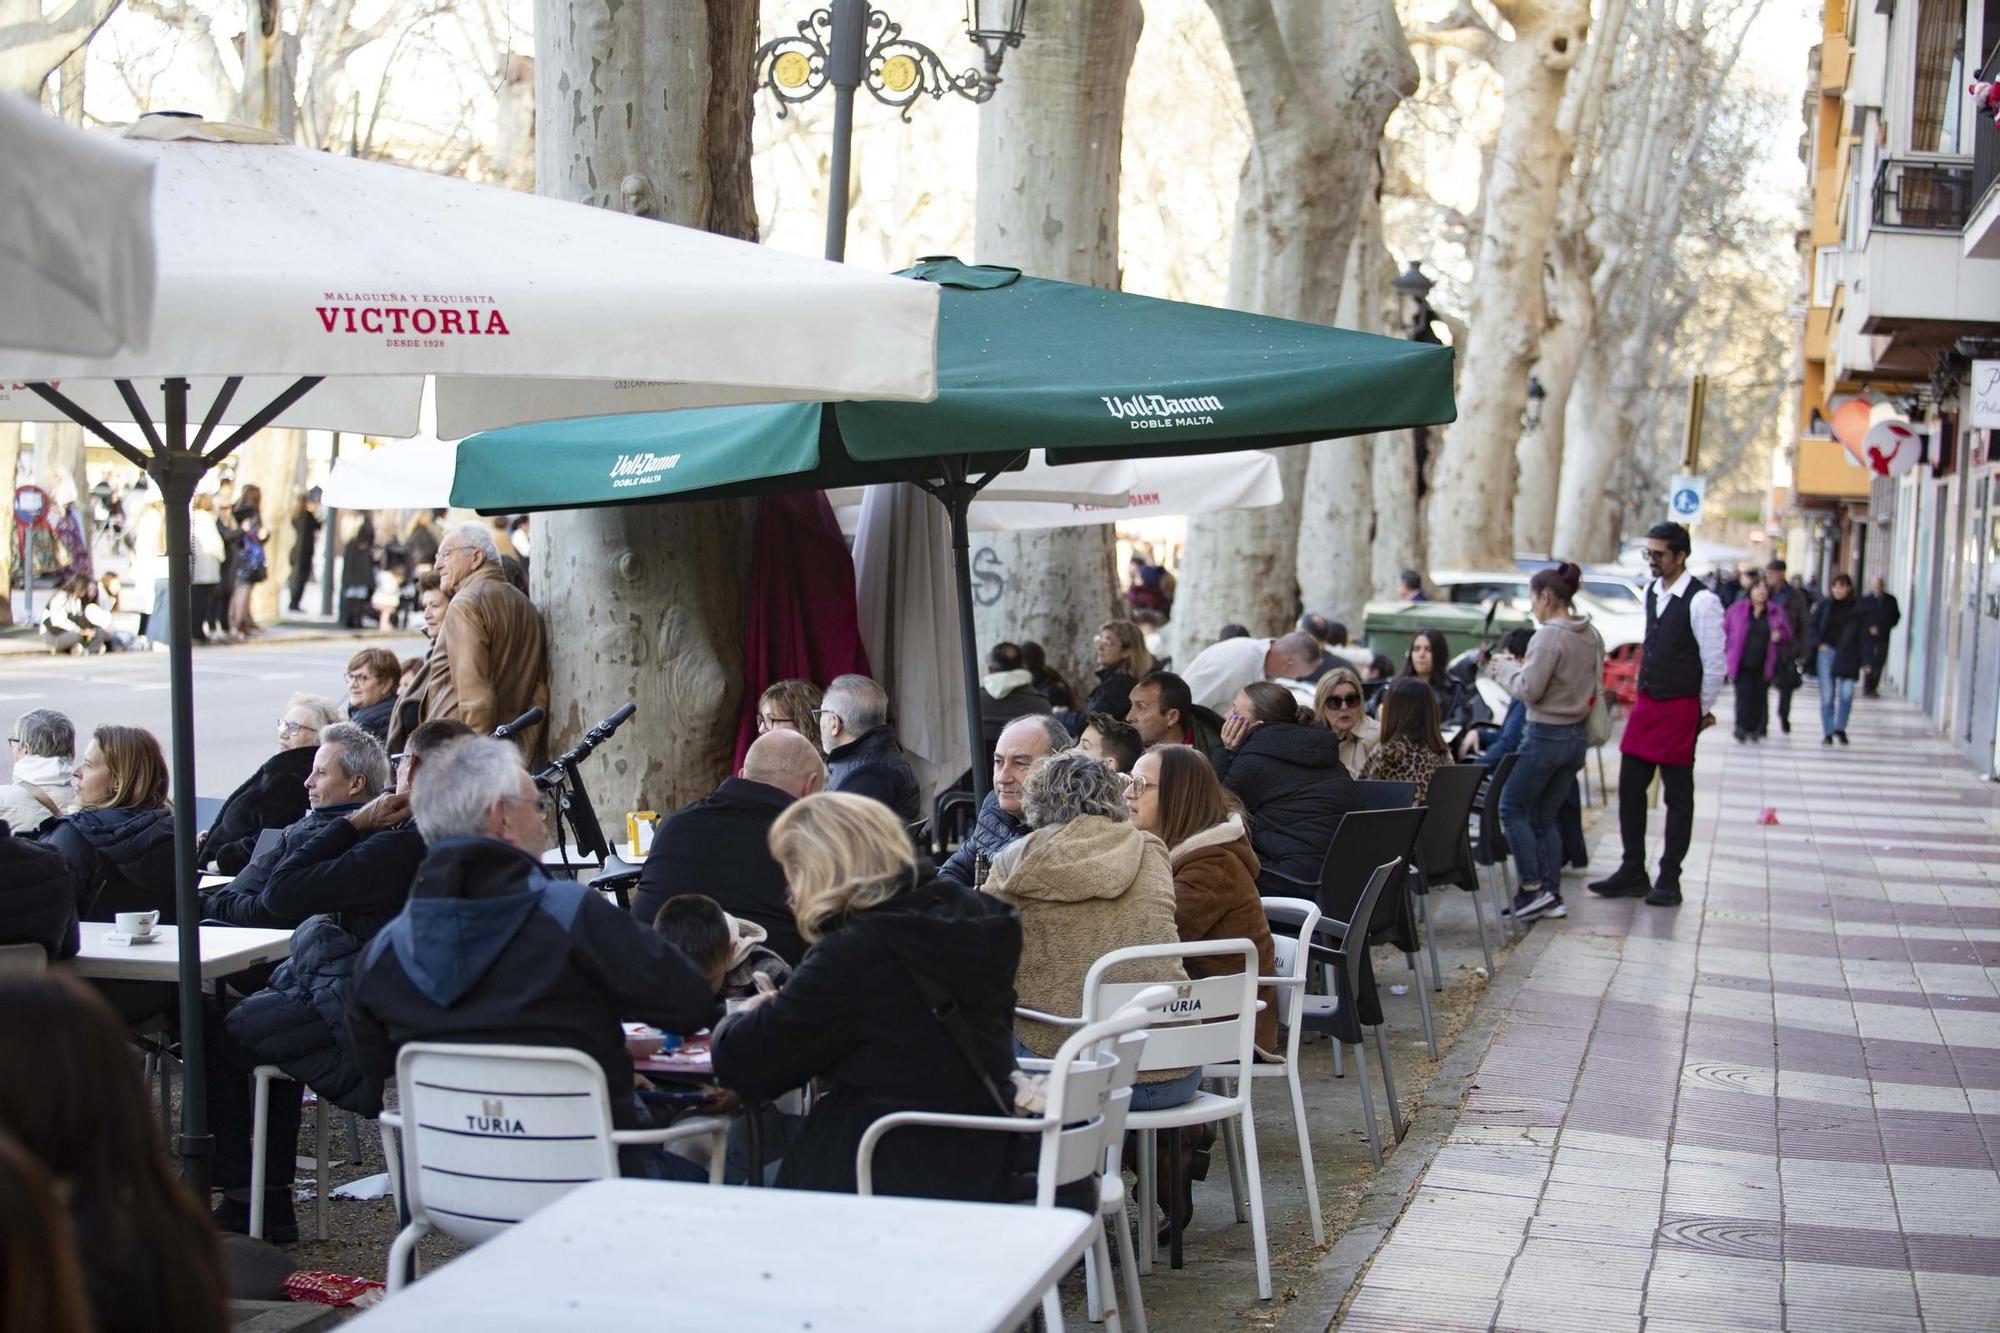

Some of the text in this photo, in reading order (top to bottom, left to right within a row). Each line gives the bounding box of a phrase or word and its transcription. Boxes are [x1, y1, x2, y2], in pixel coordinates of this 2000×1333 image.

[324, 292, 496, 304] MALAGUEÑA Y EXQUISITA
[316, 307, 510, 335] VICTORIA
[386, 339, 421, 348] DESDE
[1130, 415, 1215, 430] DOBLE MALTA
[612, 474, 663, 488] DOBLE MALTA
[466, 1114, 526, 1134] TURIA
